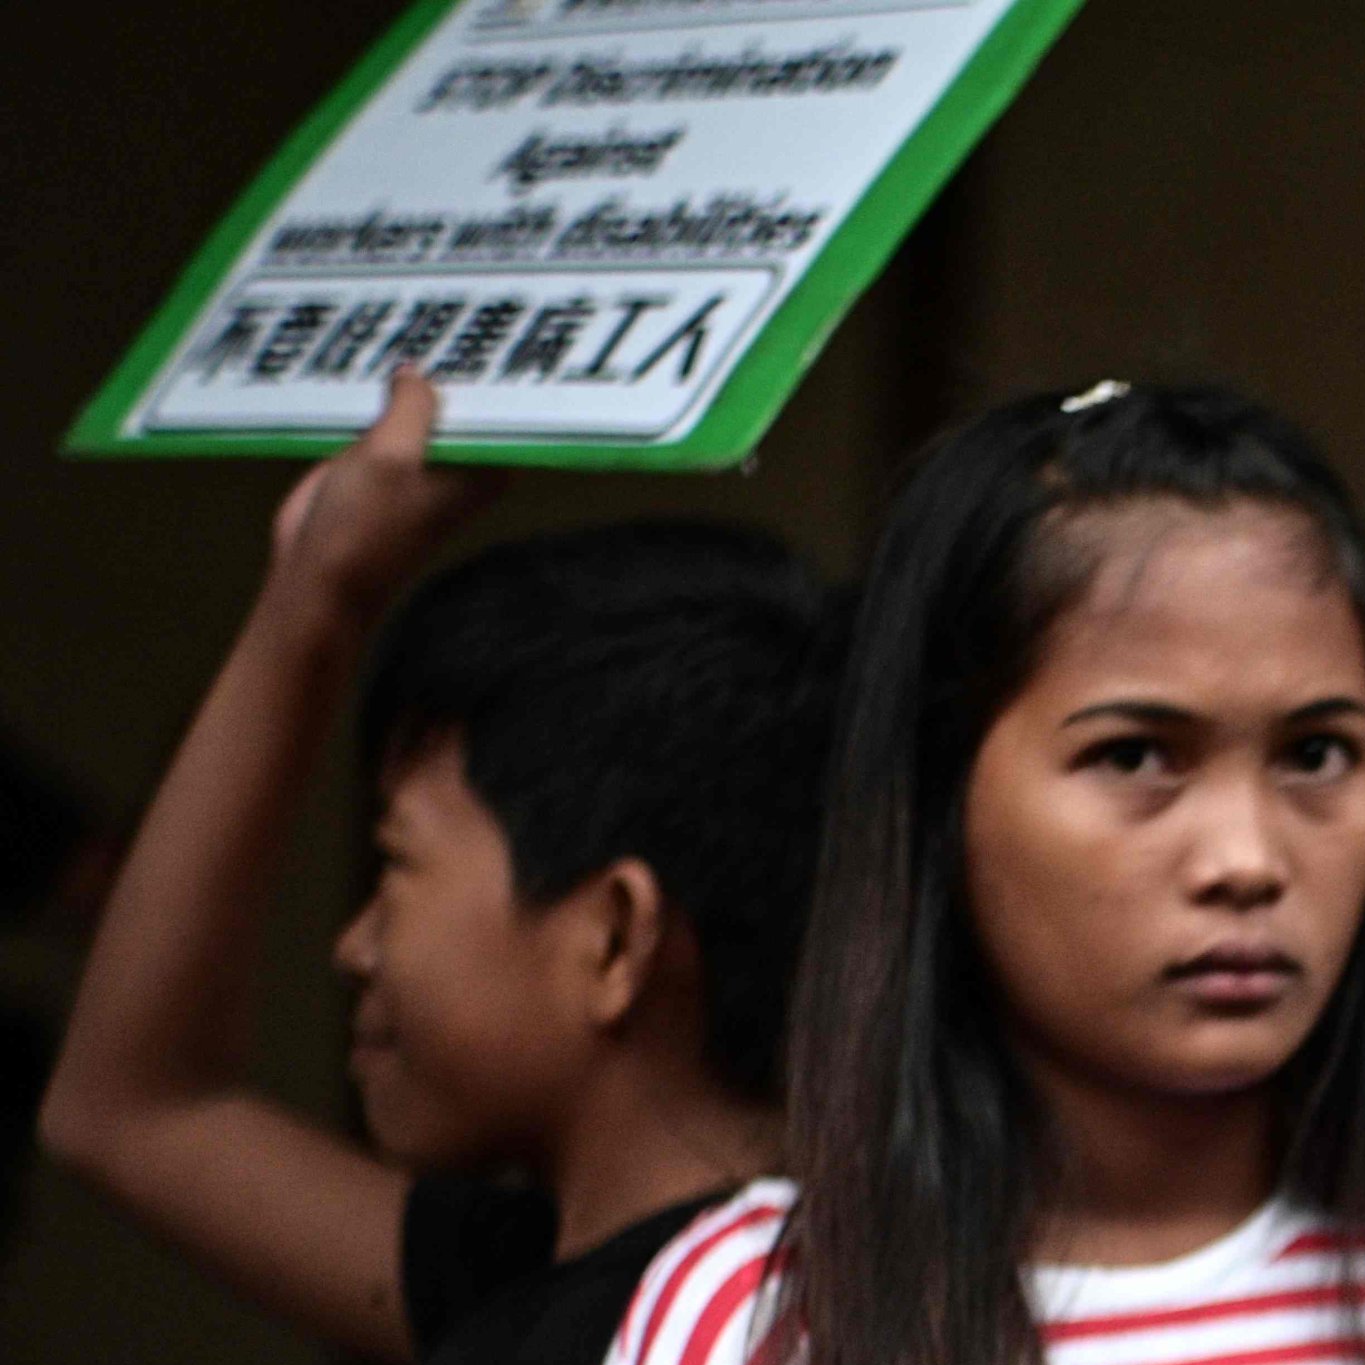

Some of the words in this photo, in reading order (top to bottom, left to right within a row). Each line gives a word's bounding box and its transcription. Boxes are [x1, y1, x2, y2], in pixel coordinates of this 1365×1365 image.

[490, 121, 687, 194] Against
[264, 206, 446, 260] workers
[428, 203, 560, 258] with
[545, 192, 826, 258] disabilities
